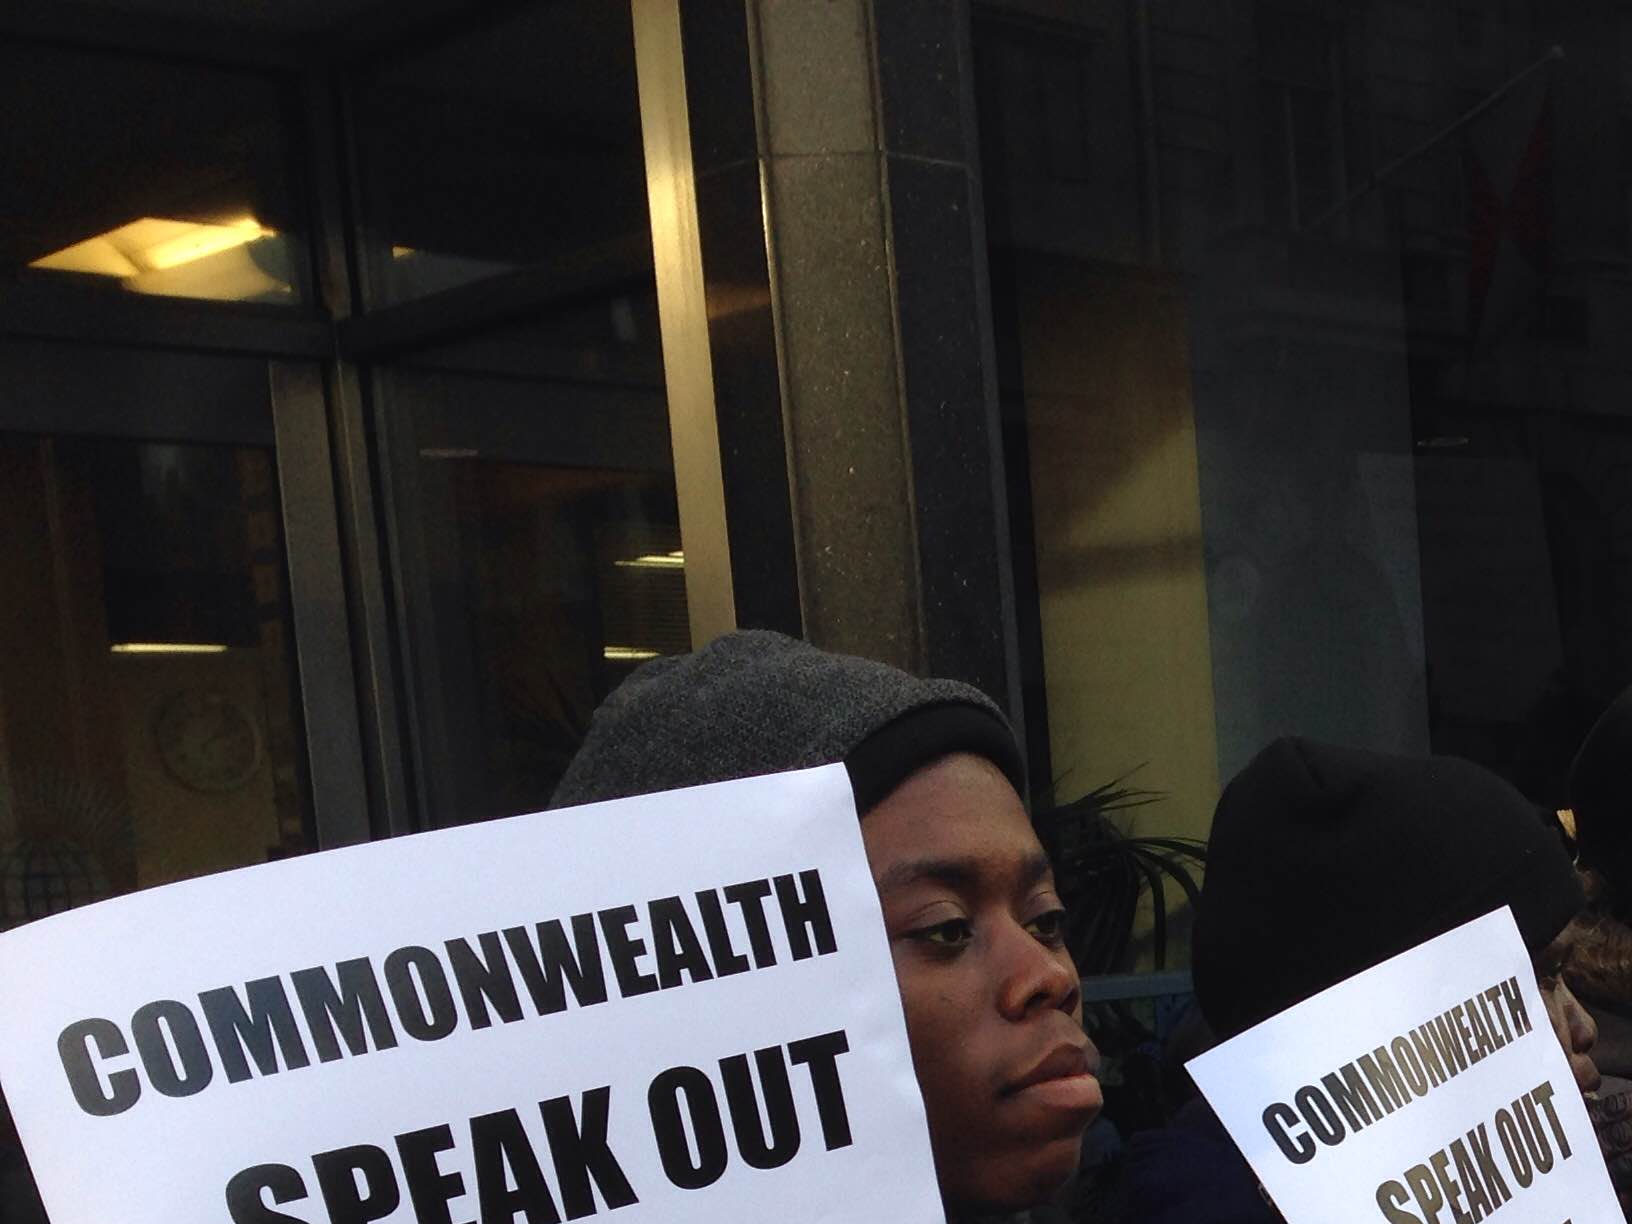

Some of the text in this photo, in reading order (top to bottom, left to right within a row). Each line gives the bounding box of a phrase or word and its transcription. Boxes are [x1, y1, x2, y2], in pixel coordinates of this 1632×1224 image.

[57, 868, 839, 1117] COMMONWEALTH
[1262, 976, 1533, 1164] COMMONWEALTH
[647, 1029, 855, 1190] OUT
[1494, 1080, 1573, 1189] OUT
